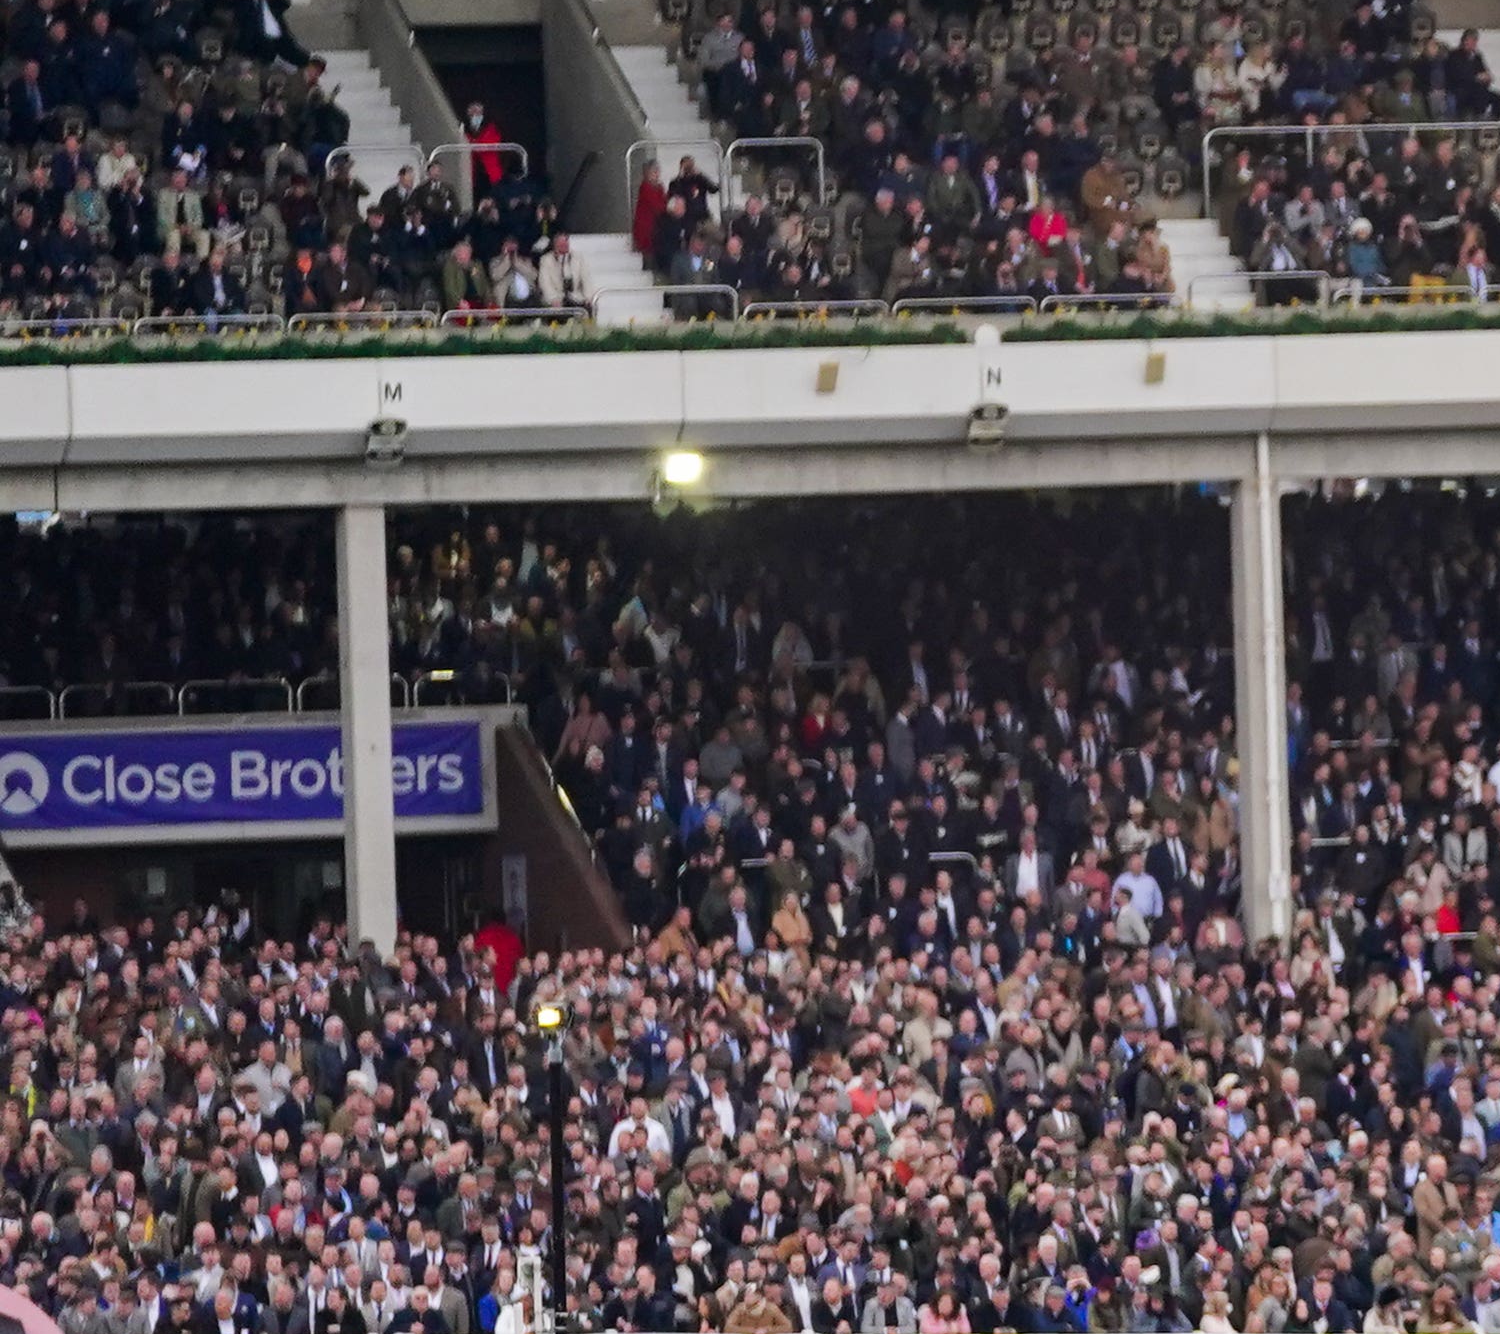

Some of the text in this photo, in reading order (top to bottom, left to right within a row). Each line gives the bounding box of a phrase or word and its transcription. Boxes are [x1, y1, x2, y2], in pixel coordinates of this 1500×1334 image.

[986, 366, 1003, 387] N
[384, 381, 403, 403] M
[62, 749, 465, 805] Close Broters
